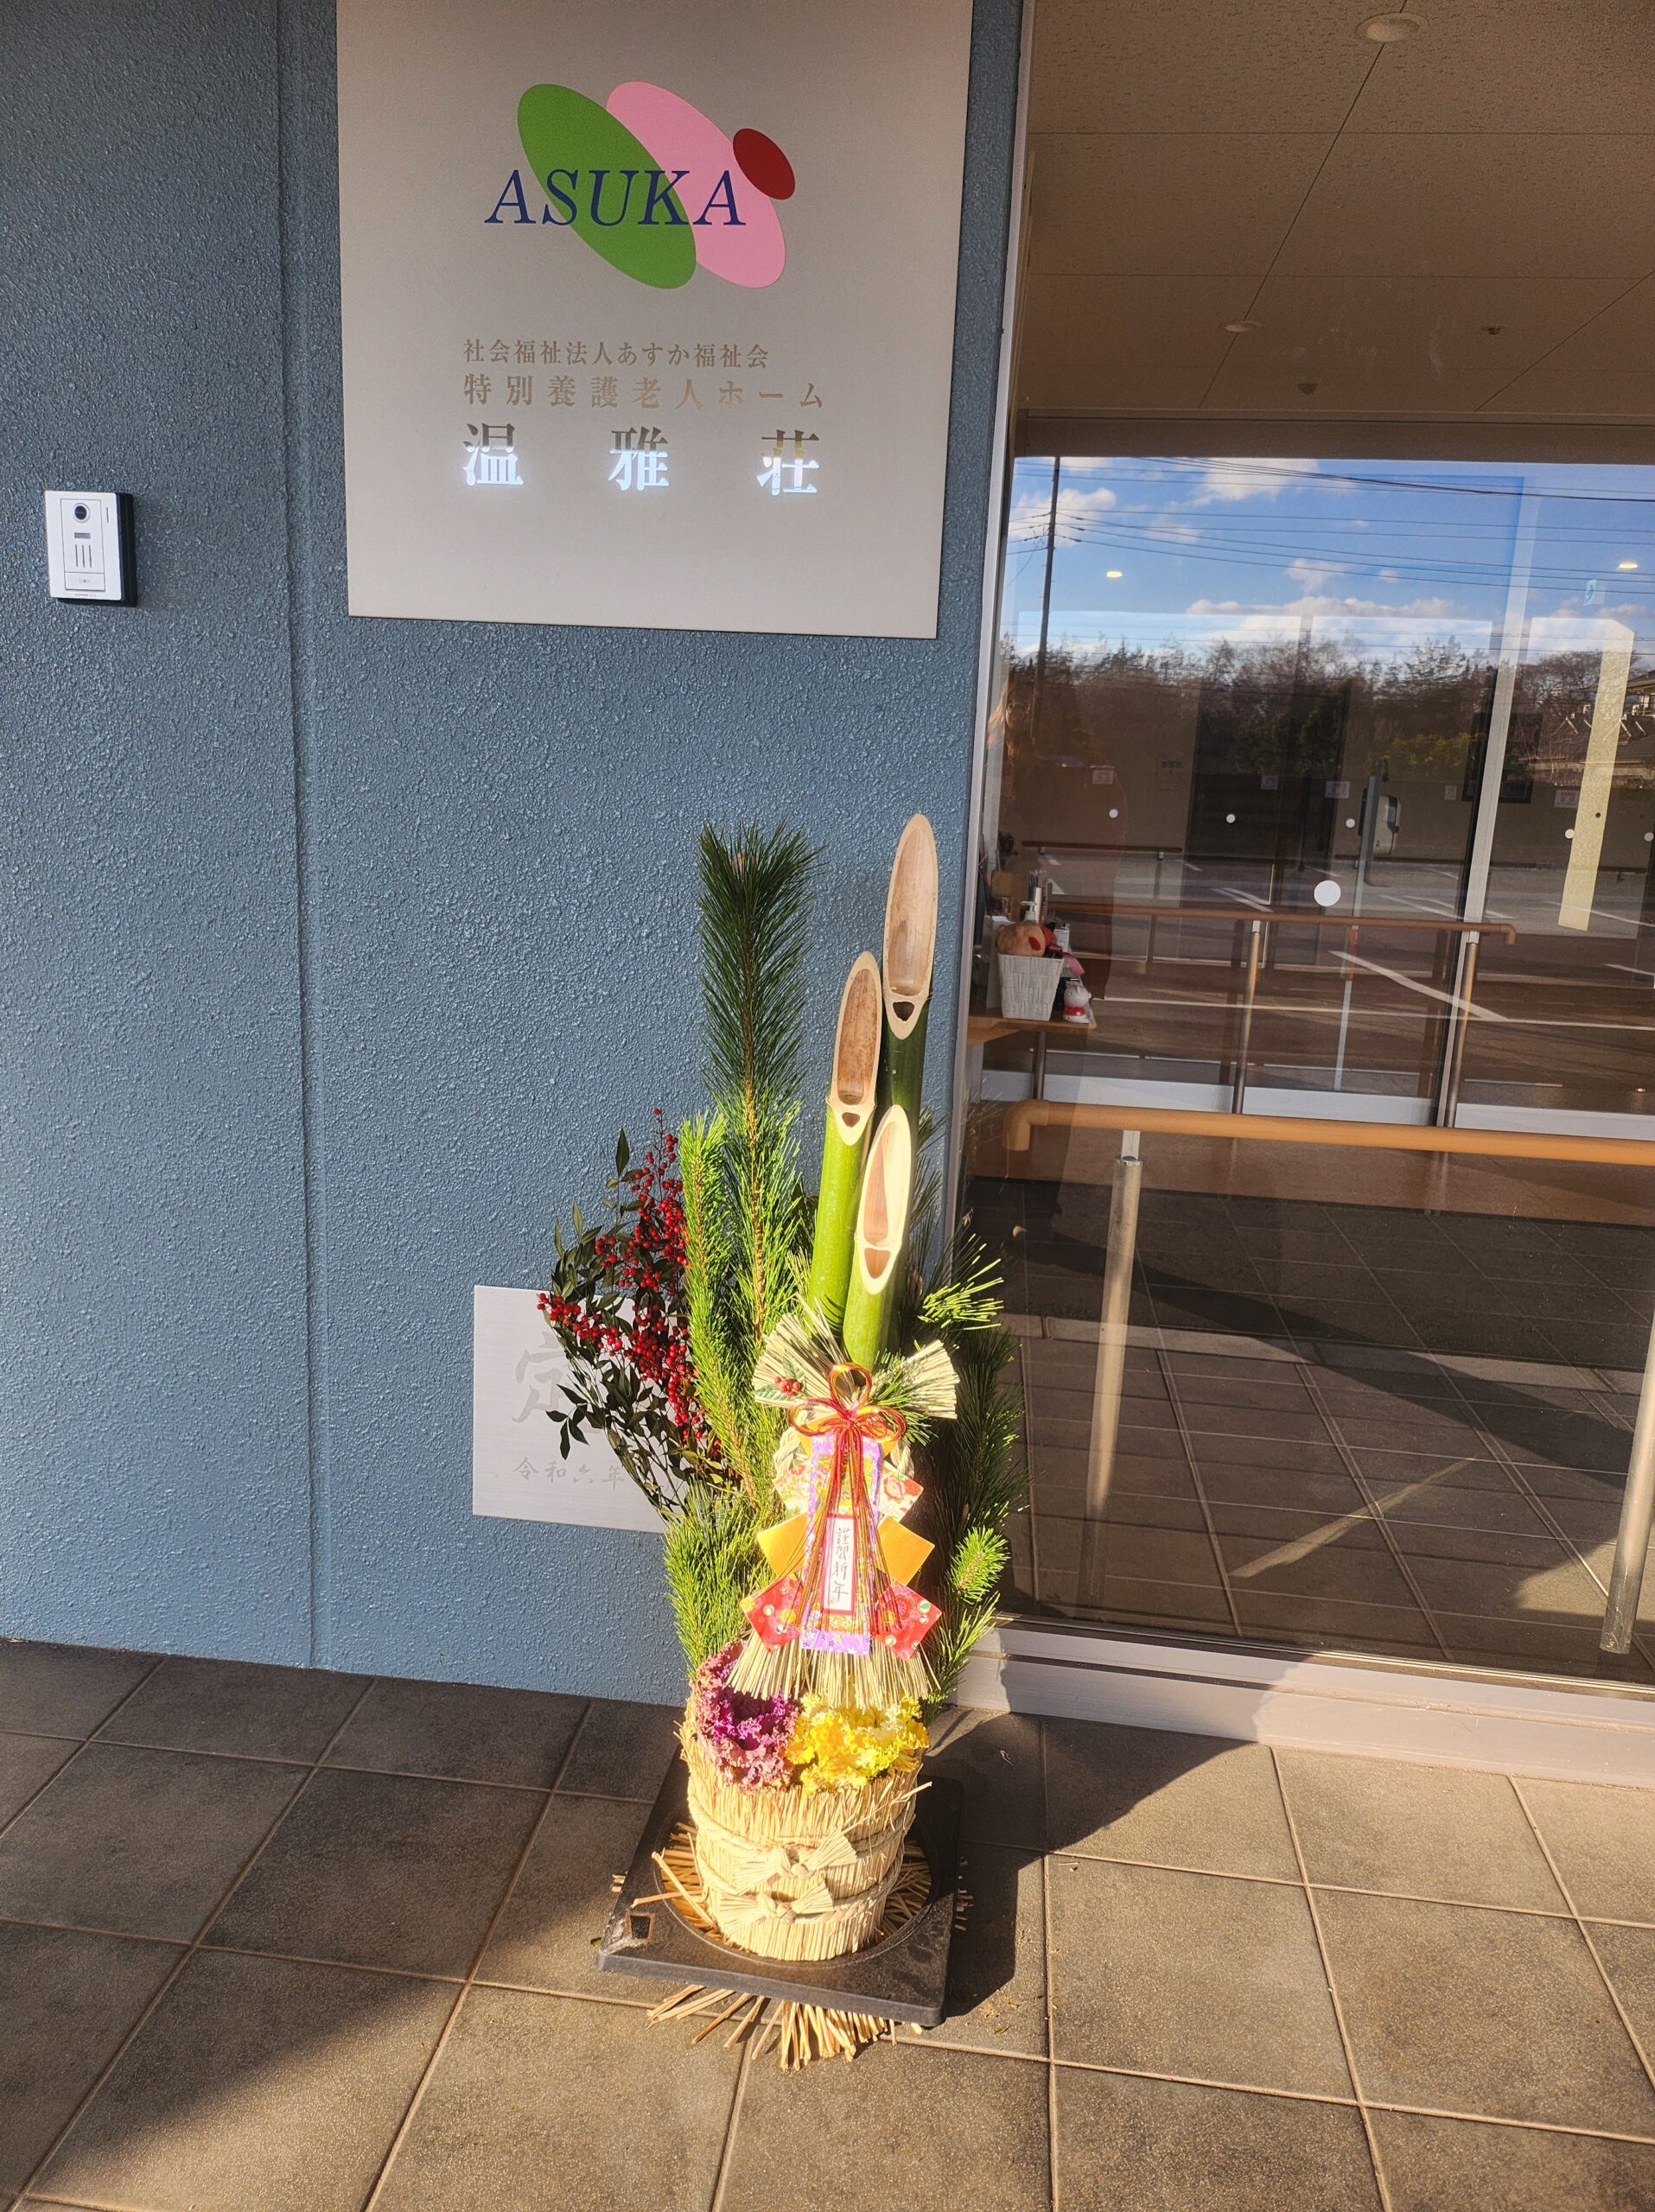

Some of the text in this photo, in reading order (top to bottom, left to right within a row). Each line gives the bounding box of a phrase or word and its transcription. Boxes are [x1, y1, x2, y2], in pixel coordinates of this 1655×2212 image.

[484, 168, 747, 226] ASUKA
[462, 338, 769, 369] 社会福祉法人あすか福祉会
[462, 372, 824, 410] 特別養護老人ホーム
[461, 422, 821, 496] 温雅荘
[831, 1527, 851, 1603] 謹賀新年
